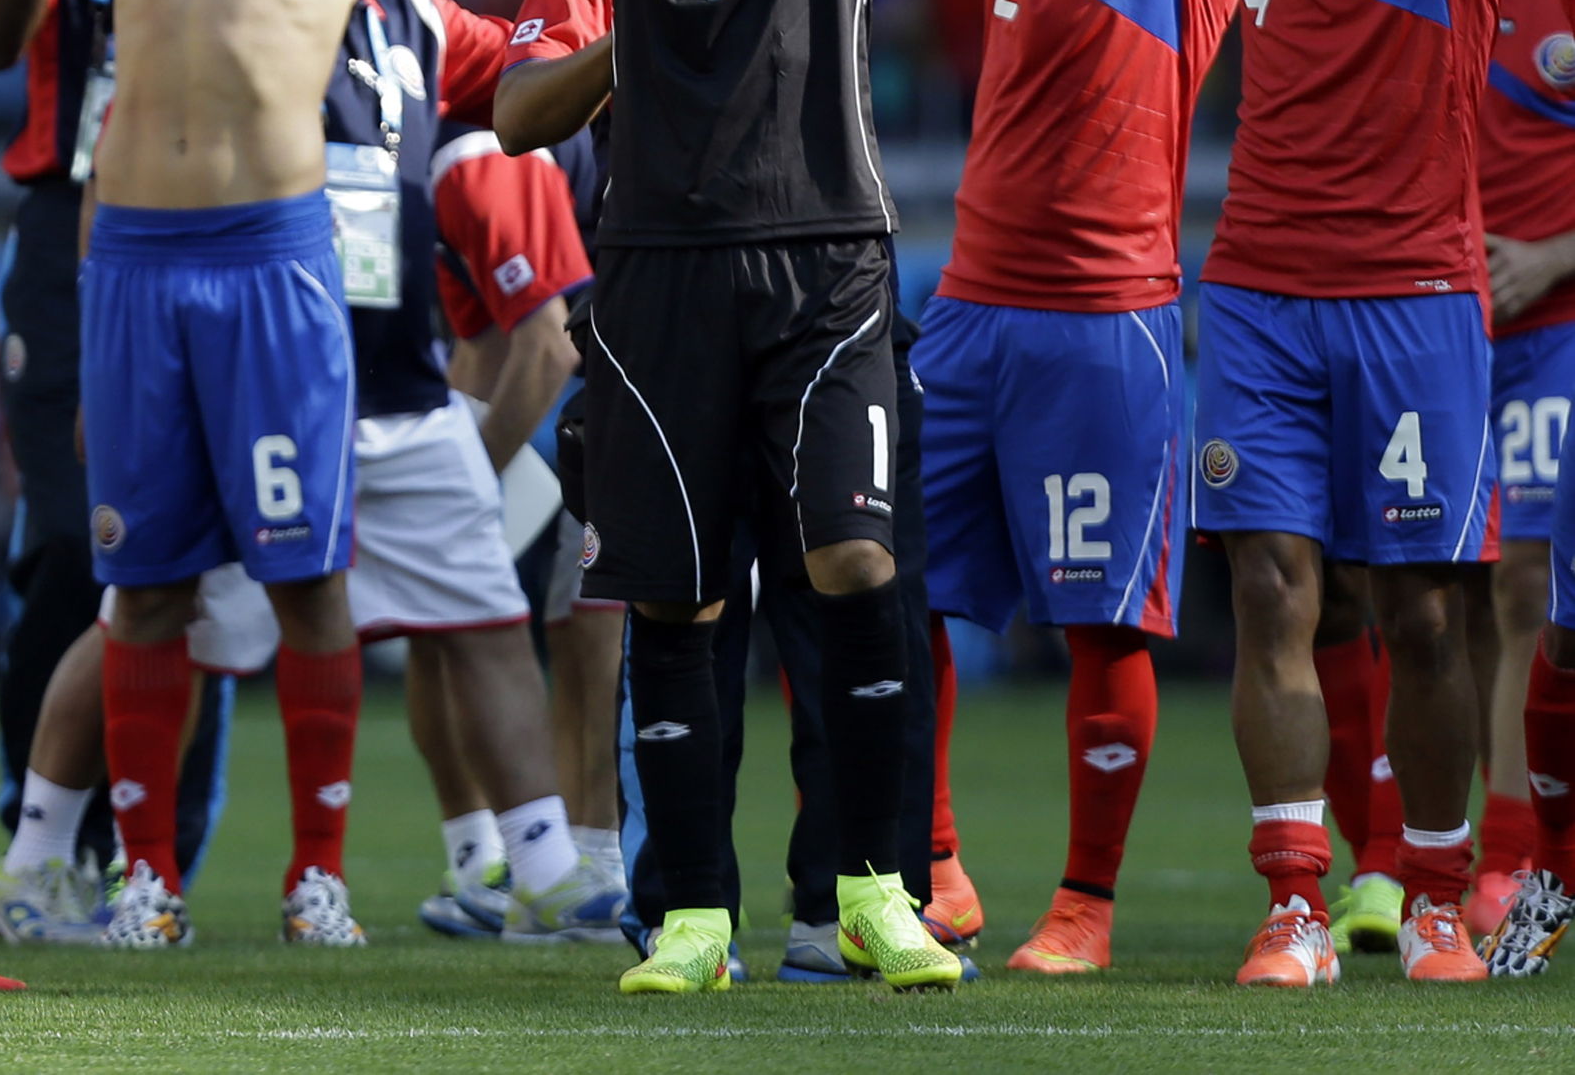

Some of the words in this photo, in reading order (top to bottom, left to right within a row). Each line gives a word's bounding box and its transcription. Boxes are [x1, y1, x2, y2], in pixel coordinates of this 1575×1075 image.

[252, 433, 304, 521] 6
[867, 404, 889, 493] 1
[1378, 411, 1428, 499] 4
[1500, 396, 1571, 482] 20
[1044, 472, 1112, 561] 12
